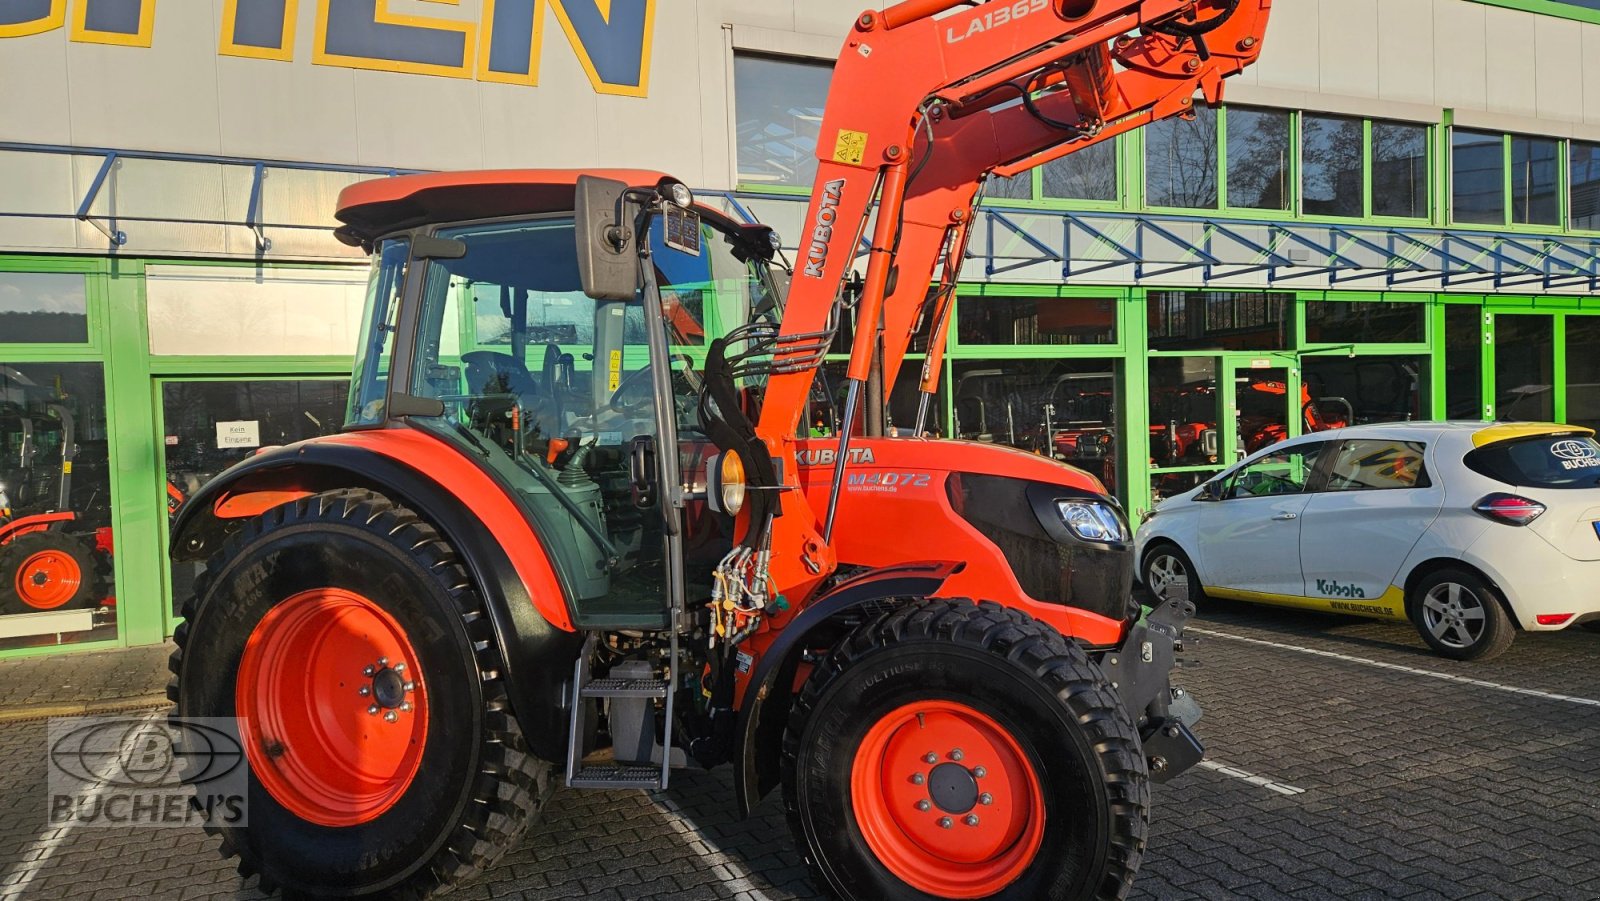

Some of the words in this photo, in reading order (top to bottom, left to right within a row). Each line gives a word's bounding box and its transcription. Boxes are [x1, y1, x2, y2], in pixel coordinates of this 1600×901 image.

[946, 0, 1049, 44] LA1365
[804, 178, 846, 279] KUBOTA
[847, 472, 931, 487] M4072
[1316, 579, 1365, 598] Kubota
[1329, 601, 1395, 616] WWW.BUCHENS.DE
